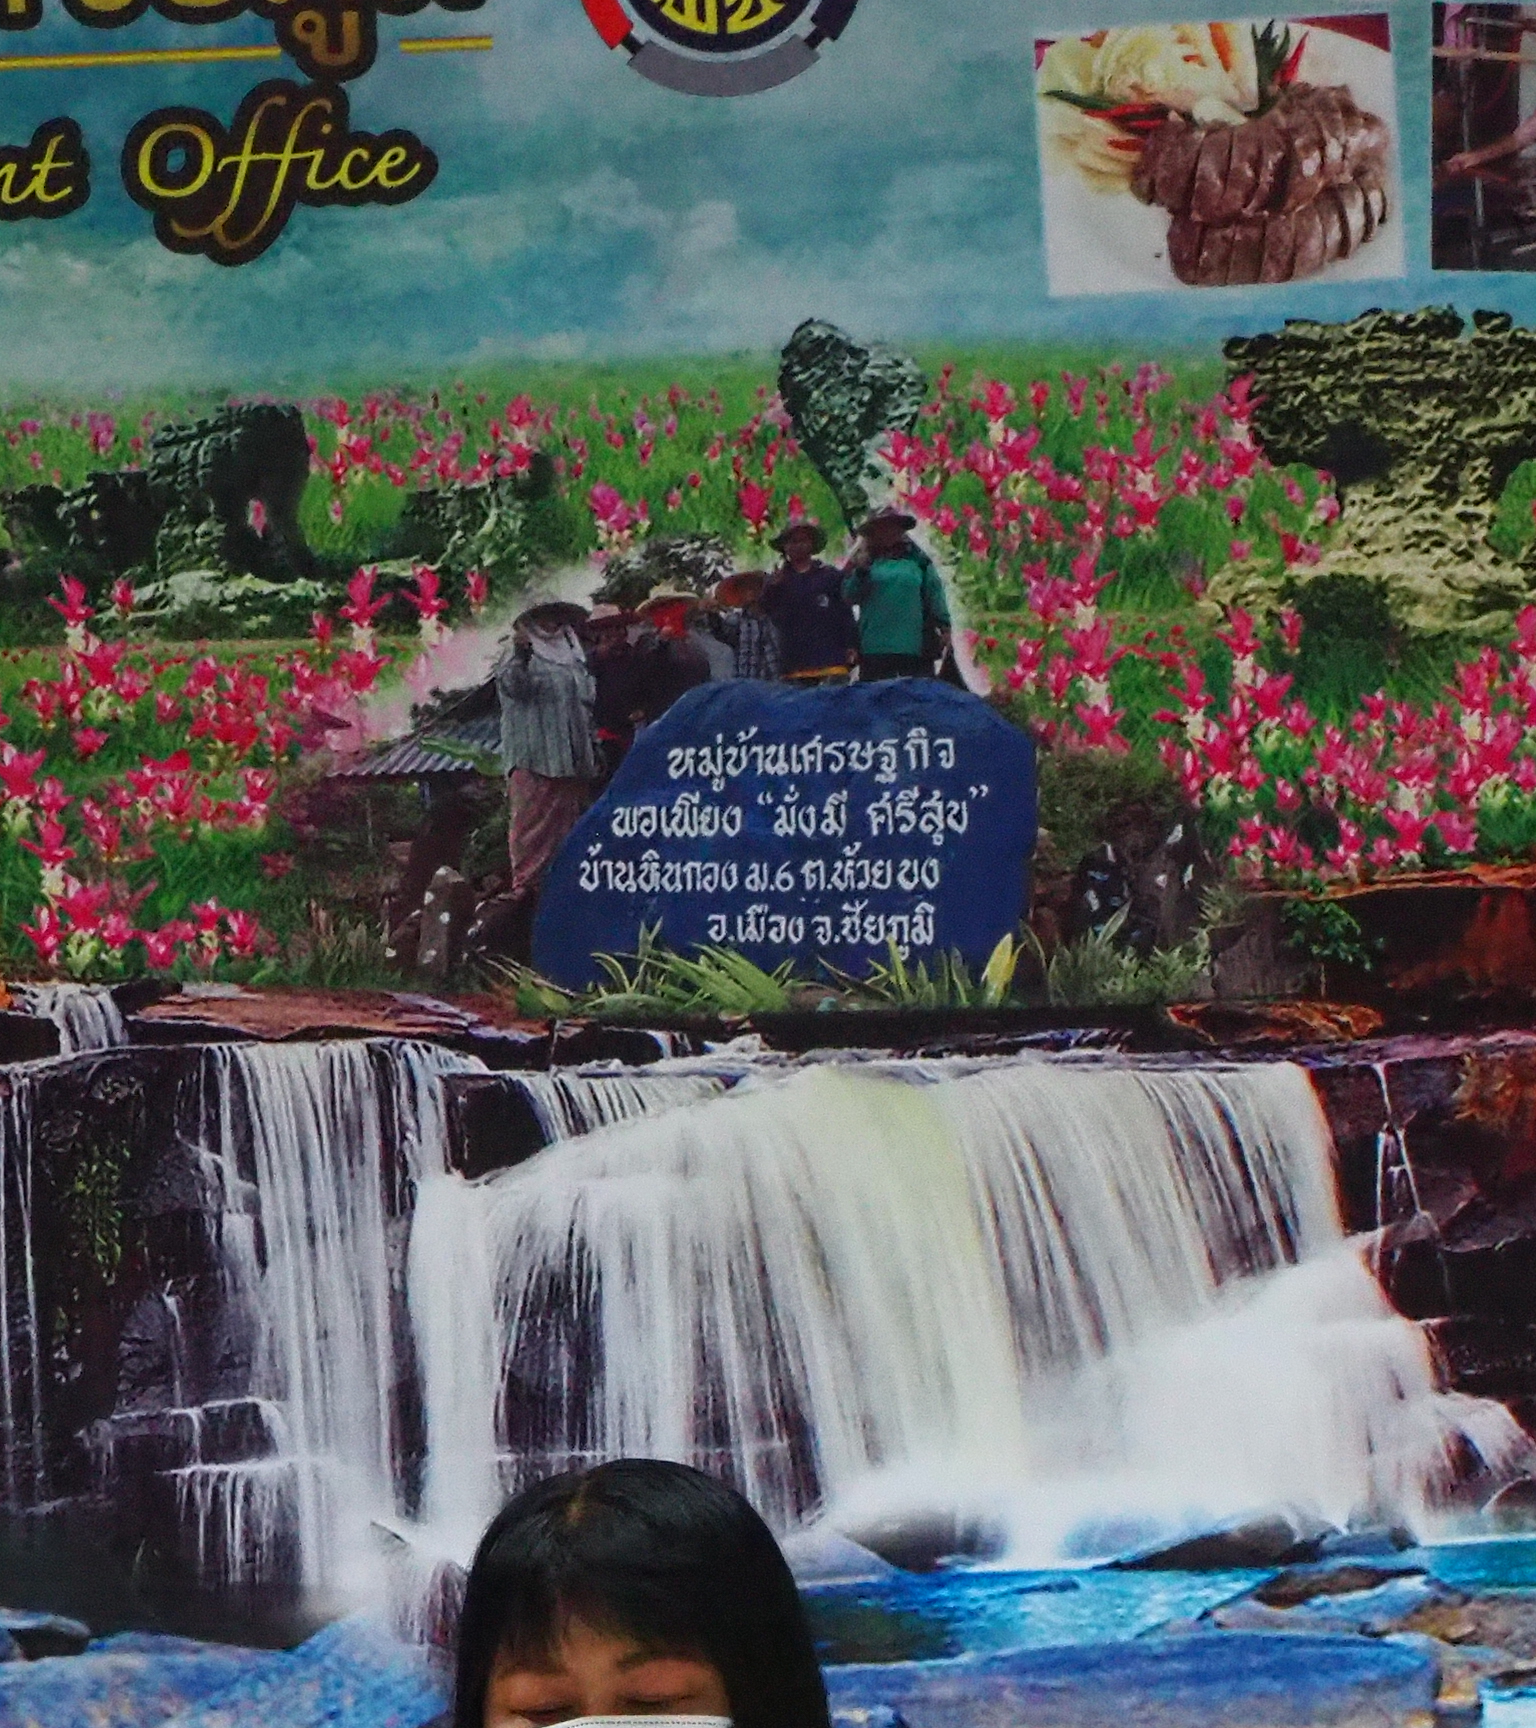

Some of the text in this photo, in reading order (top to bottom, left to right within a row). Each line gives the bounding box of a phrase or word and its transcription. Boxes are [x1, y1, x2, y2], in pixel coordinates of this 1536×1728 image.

[137, 95, 420, 238] Office
[611, 791, 742, 838] พอเพียง
